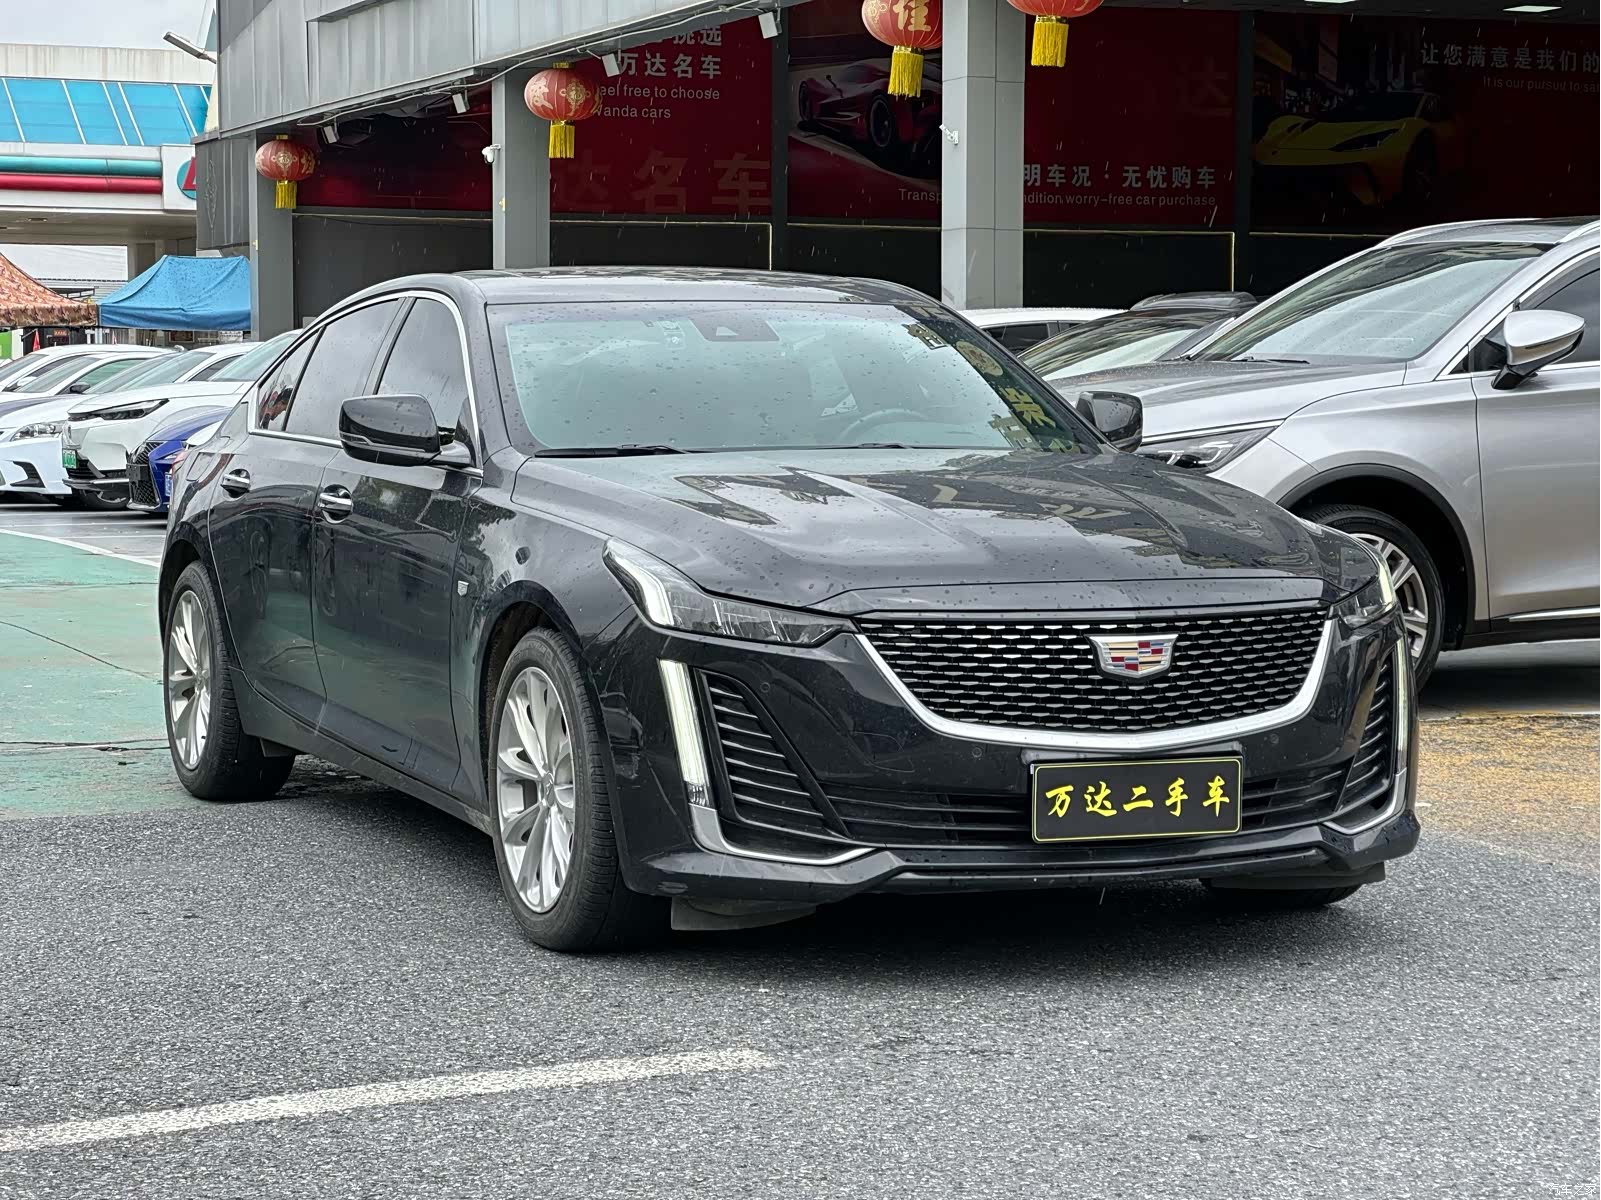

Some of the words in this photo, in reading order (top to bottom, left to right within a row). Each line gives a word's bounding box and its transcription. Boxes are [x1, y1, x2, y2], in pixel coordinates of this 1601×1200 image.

[618, 52, 722, 79] 万达名车
[1420, 42, 1600, 74] 让您满意是我们的
[600, 84, 620, 97] eel
[623, 84, 651, 98] free
[654, 86, 668, 98] to
[670, 86, 720, 100] choose
[1505, 79, 1524, 89] our
[641, 107, 671, 119] cars
[1135, 195, 1155, 206] car
[1159, 193, 1216, 207] purchase
[1045, 775, 1230, 818] 万达二手车
